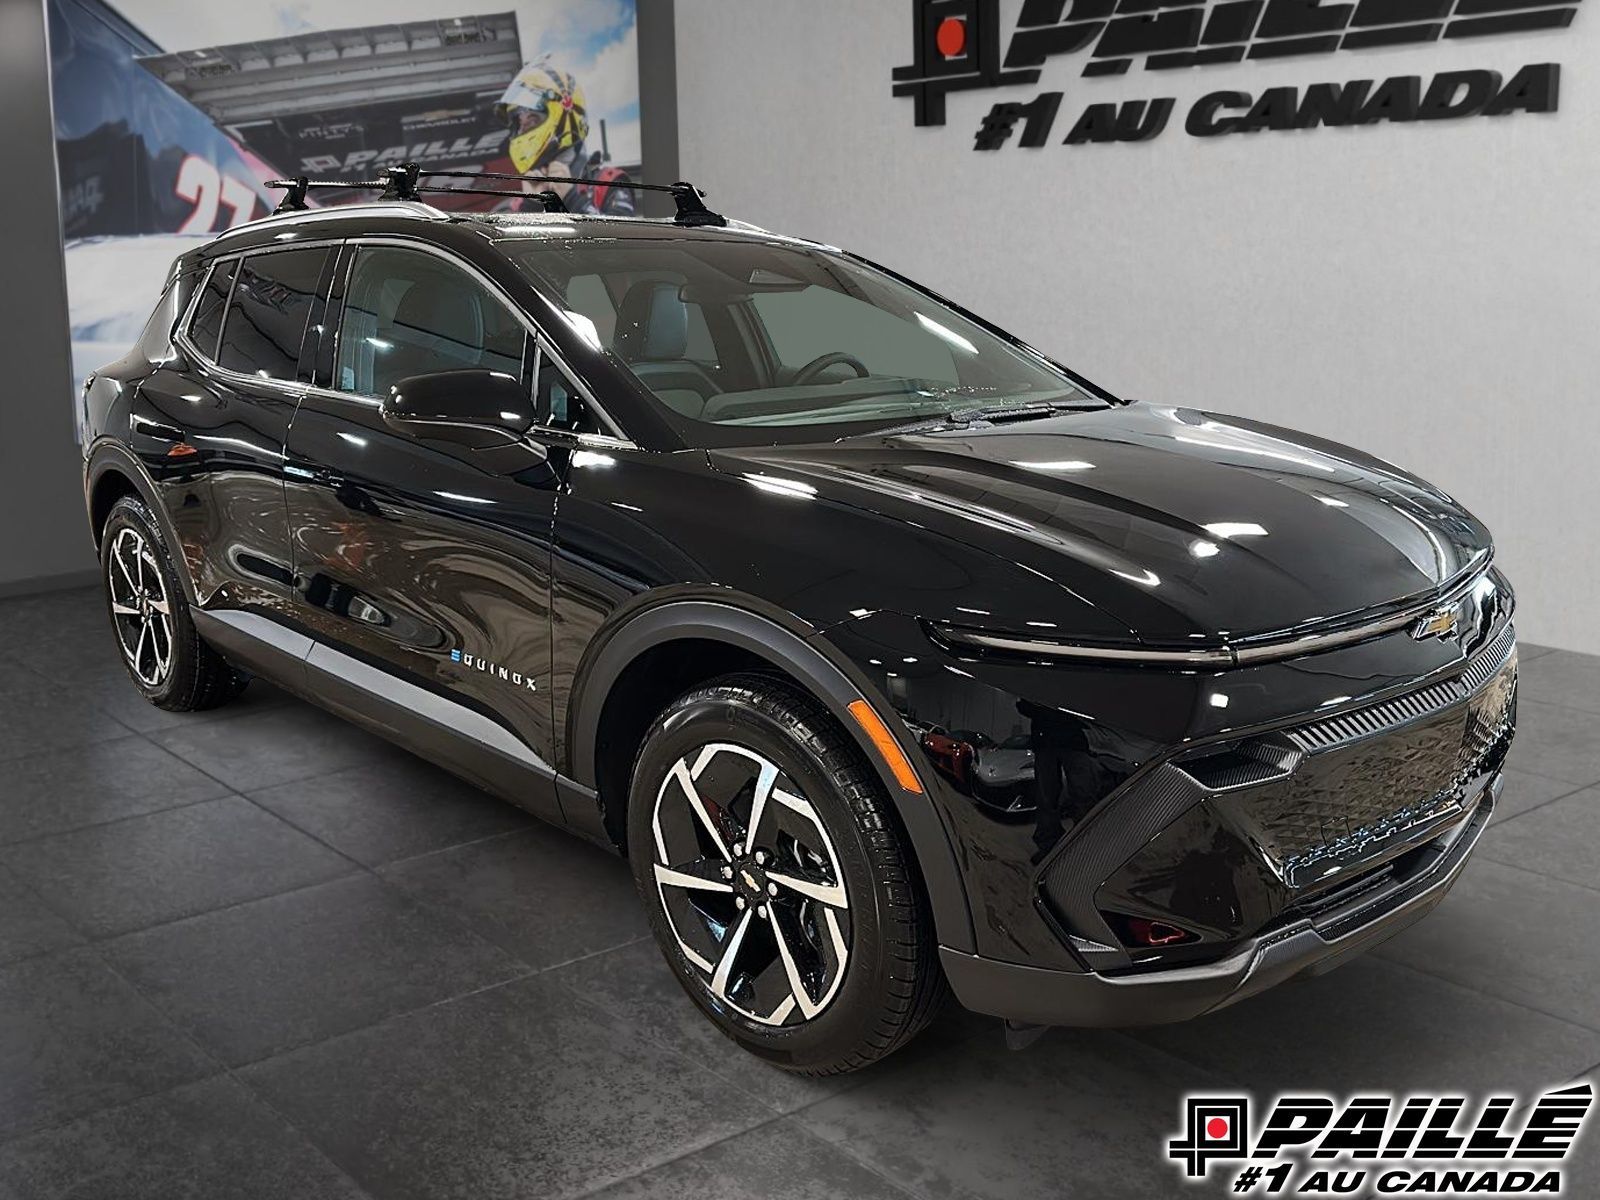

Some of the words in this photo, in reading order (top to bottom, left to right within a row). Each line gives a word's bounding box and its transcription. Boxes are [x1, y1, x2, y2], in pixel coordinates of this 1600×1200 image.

[973, 91, 1064, 150] #1
[1062, 98, 1176, 145] AU
[1184, 62, 1561, 138] CANADA
[175, 154, 256, 234] 27
[450, 648, 537, 692] EQUINOX
